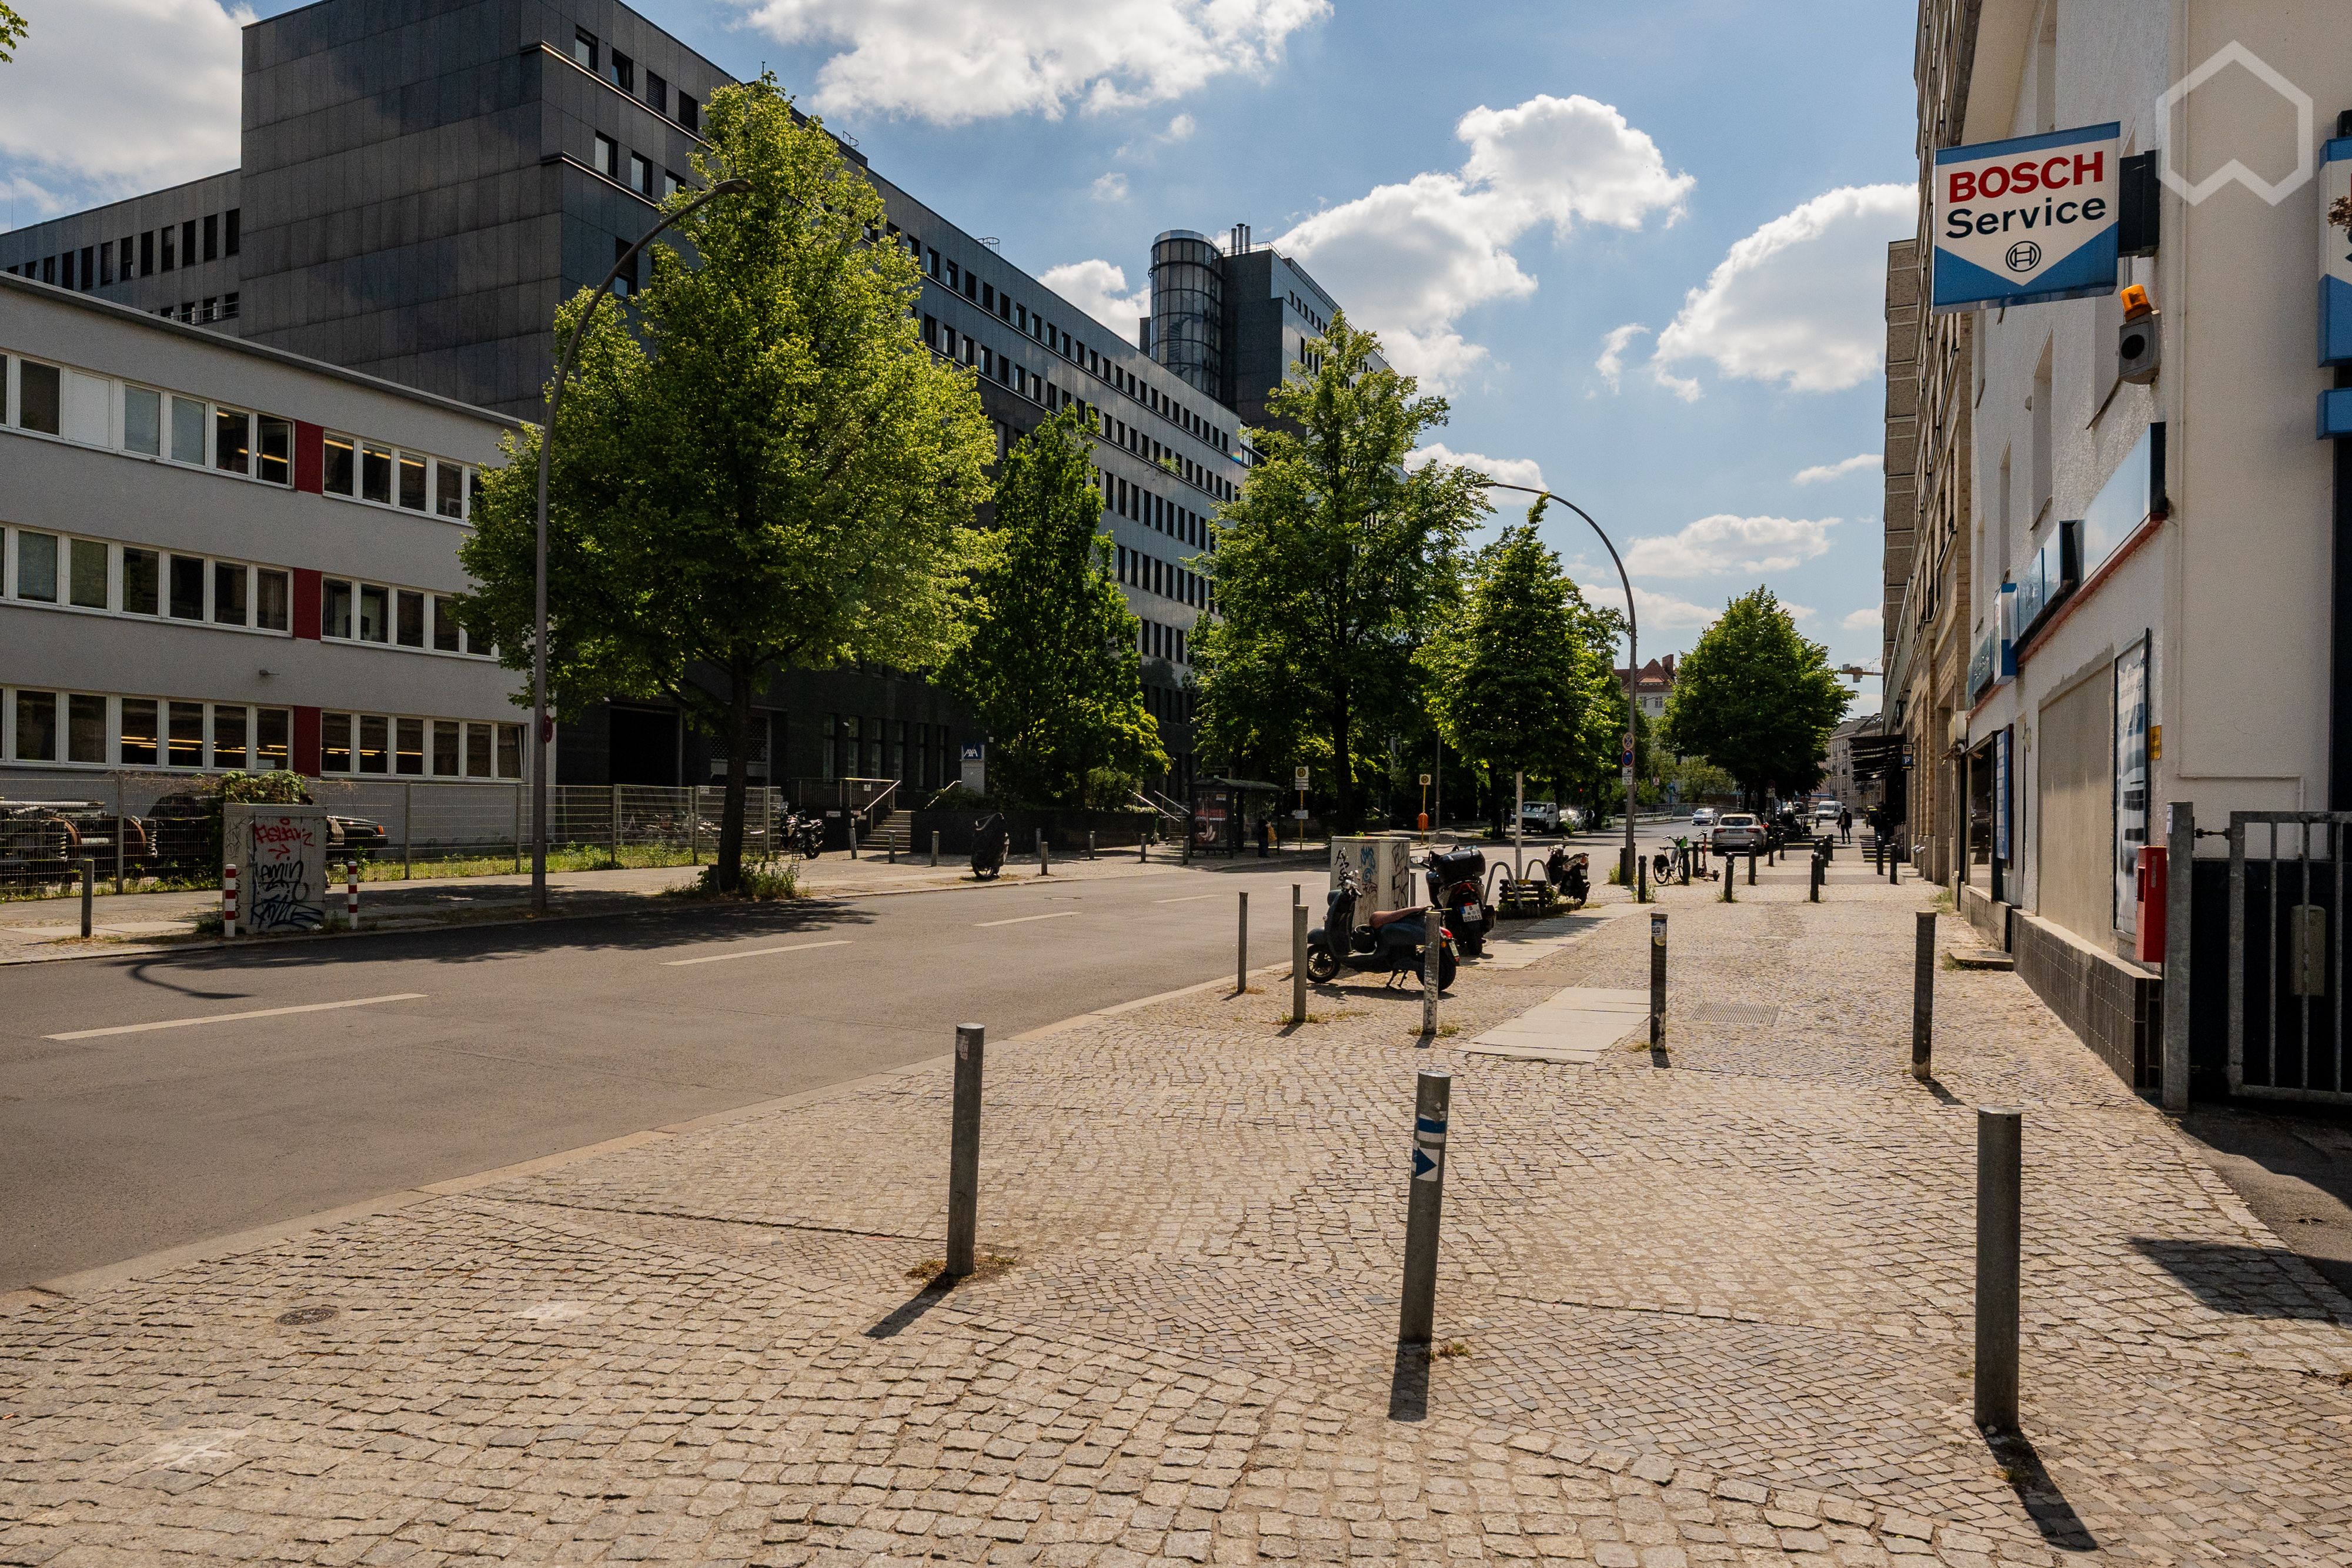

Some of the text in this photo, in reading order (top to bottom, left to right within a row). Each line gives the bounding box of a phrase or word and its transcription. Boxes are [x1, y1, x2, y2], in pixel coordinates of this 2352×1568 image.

[1949, 151, 2104, 203] BOSCH
[1945, 197, 2106, 239] Service
[963, 749, 978, 757] AXA
